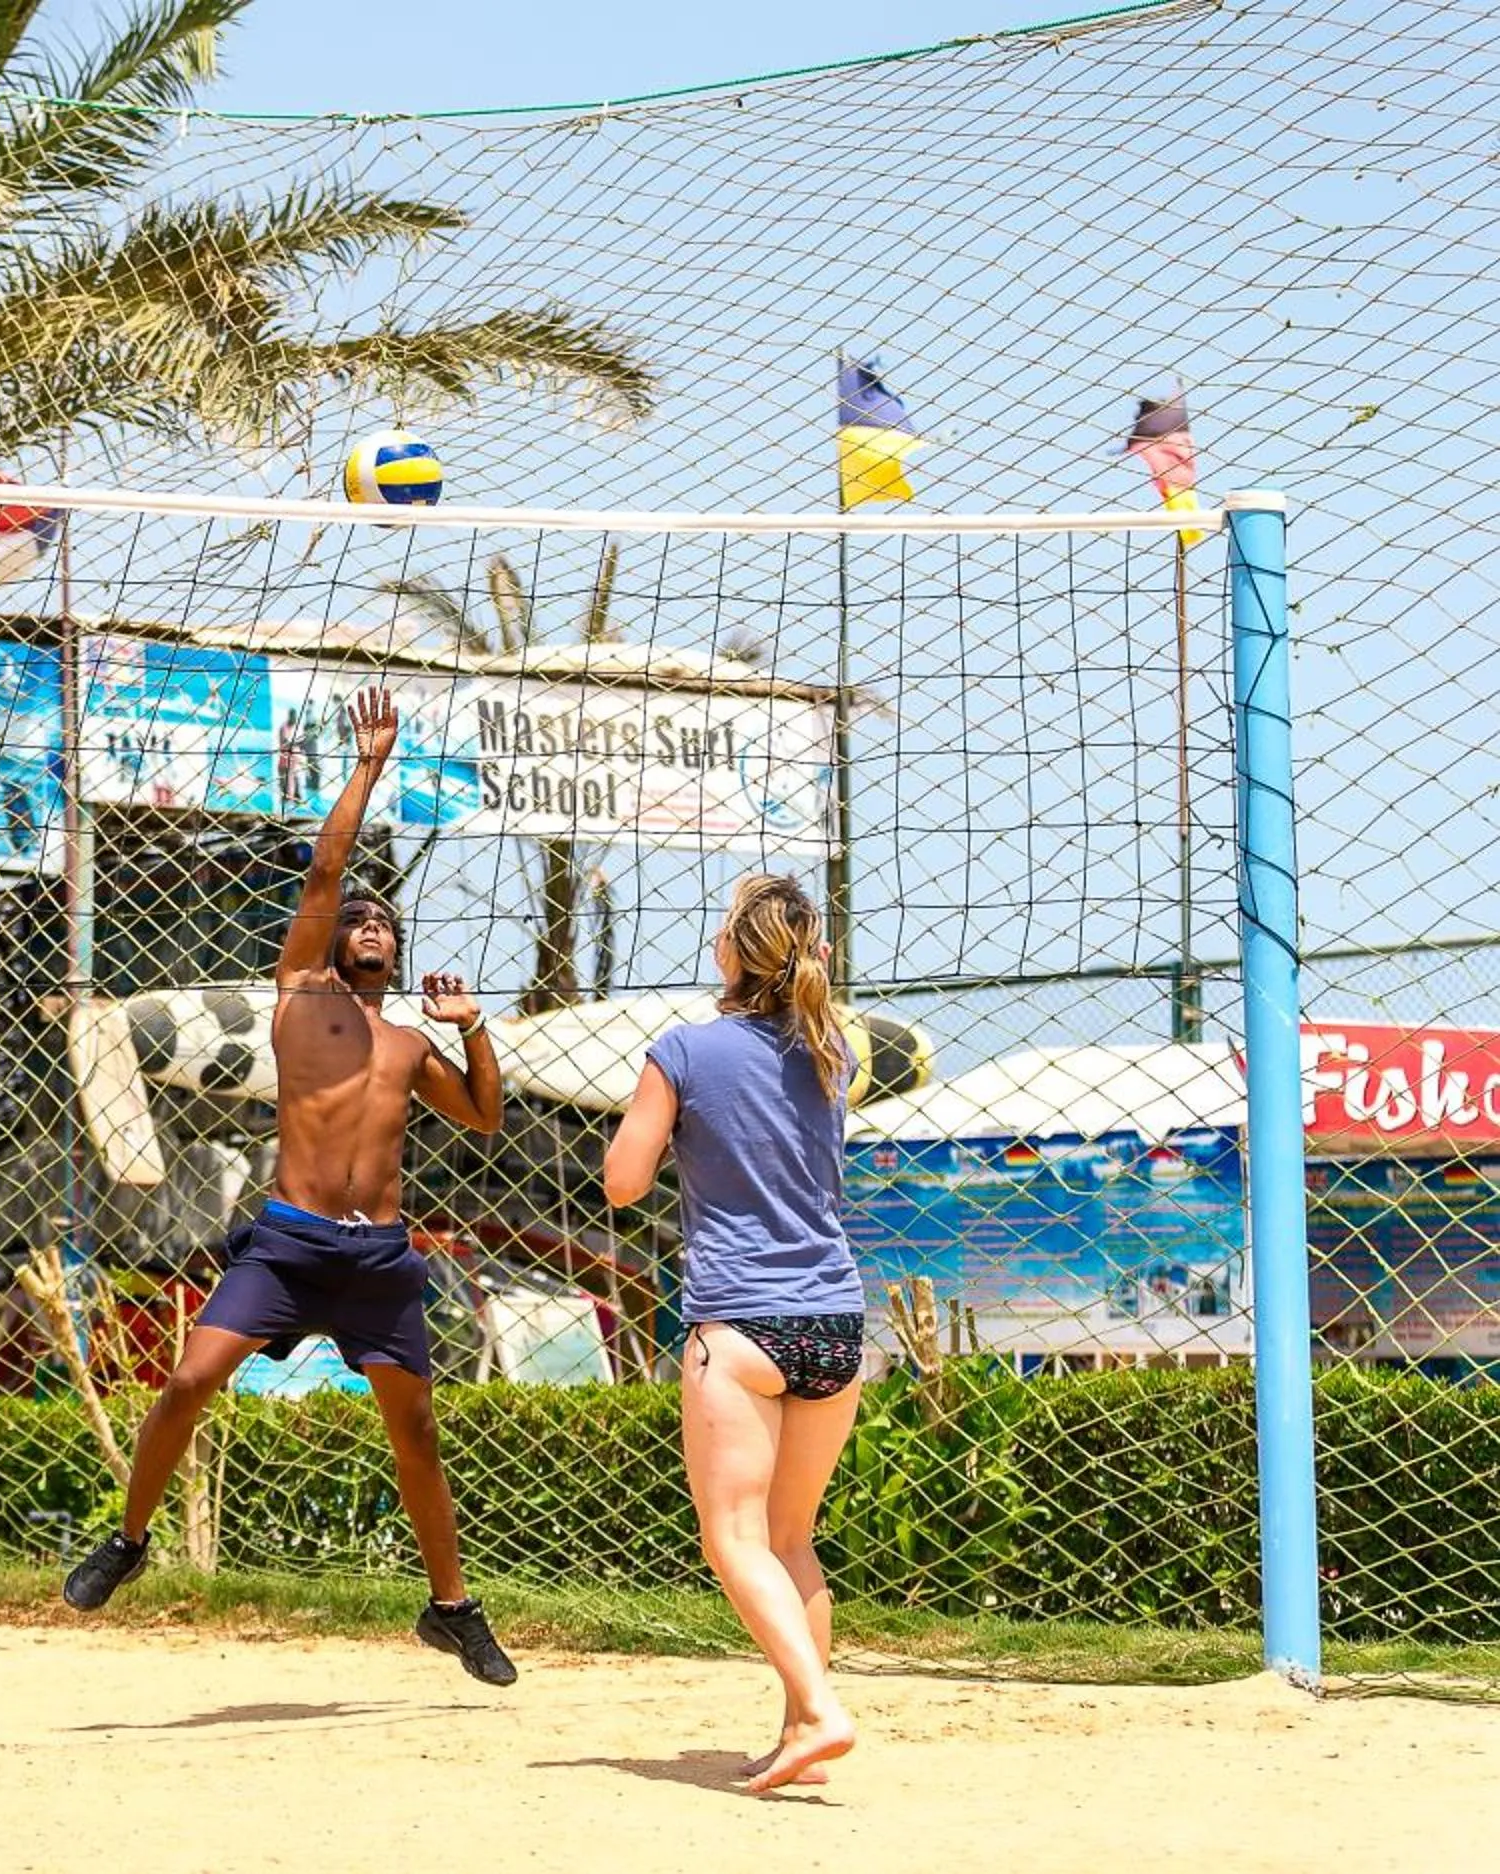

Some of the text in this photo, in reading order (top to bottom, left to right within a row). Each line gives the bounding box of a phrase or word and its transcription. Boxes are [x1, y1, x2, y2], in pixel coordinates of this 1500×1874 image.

[477, 699, 738, 774] Masters Surf
[481, 761, 617, 820] School
